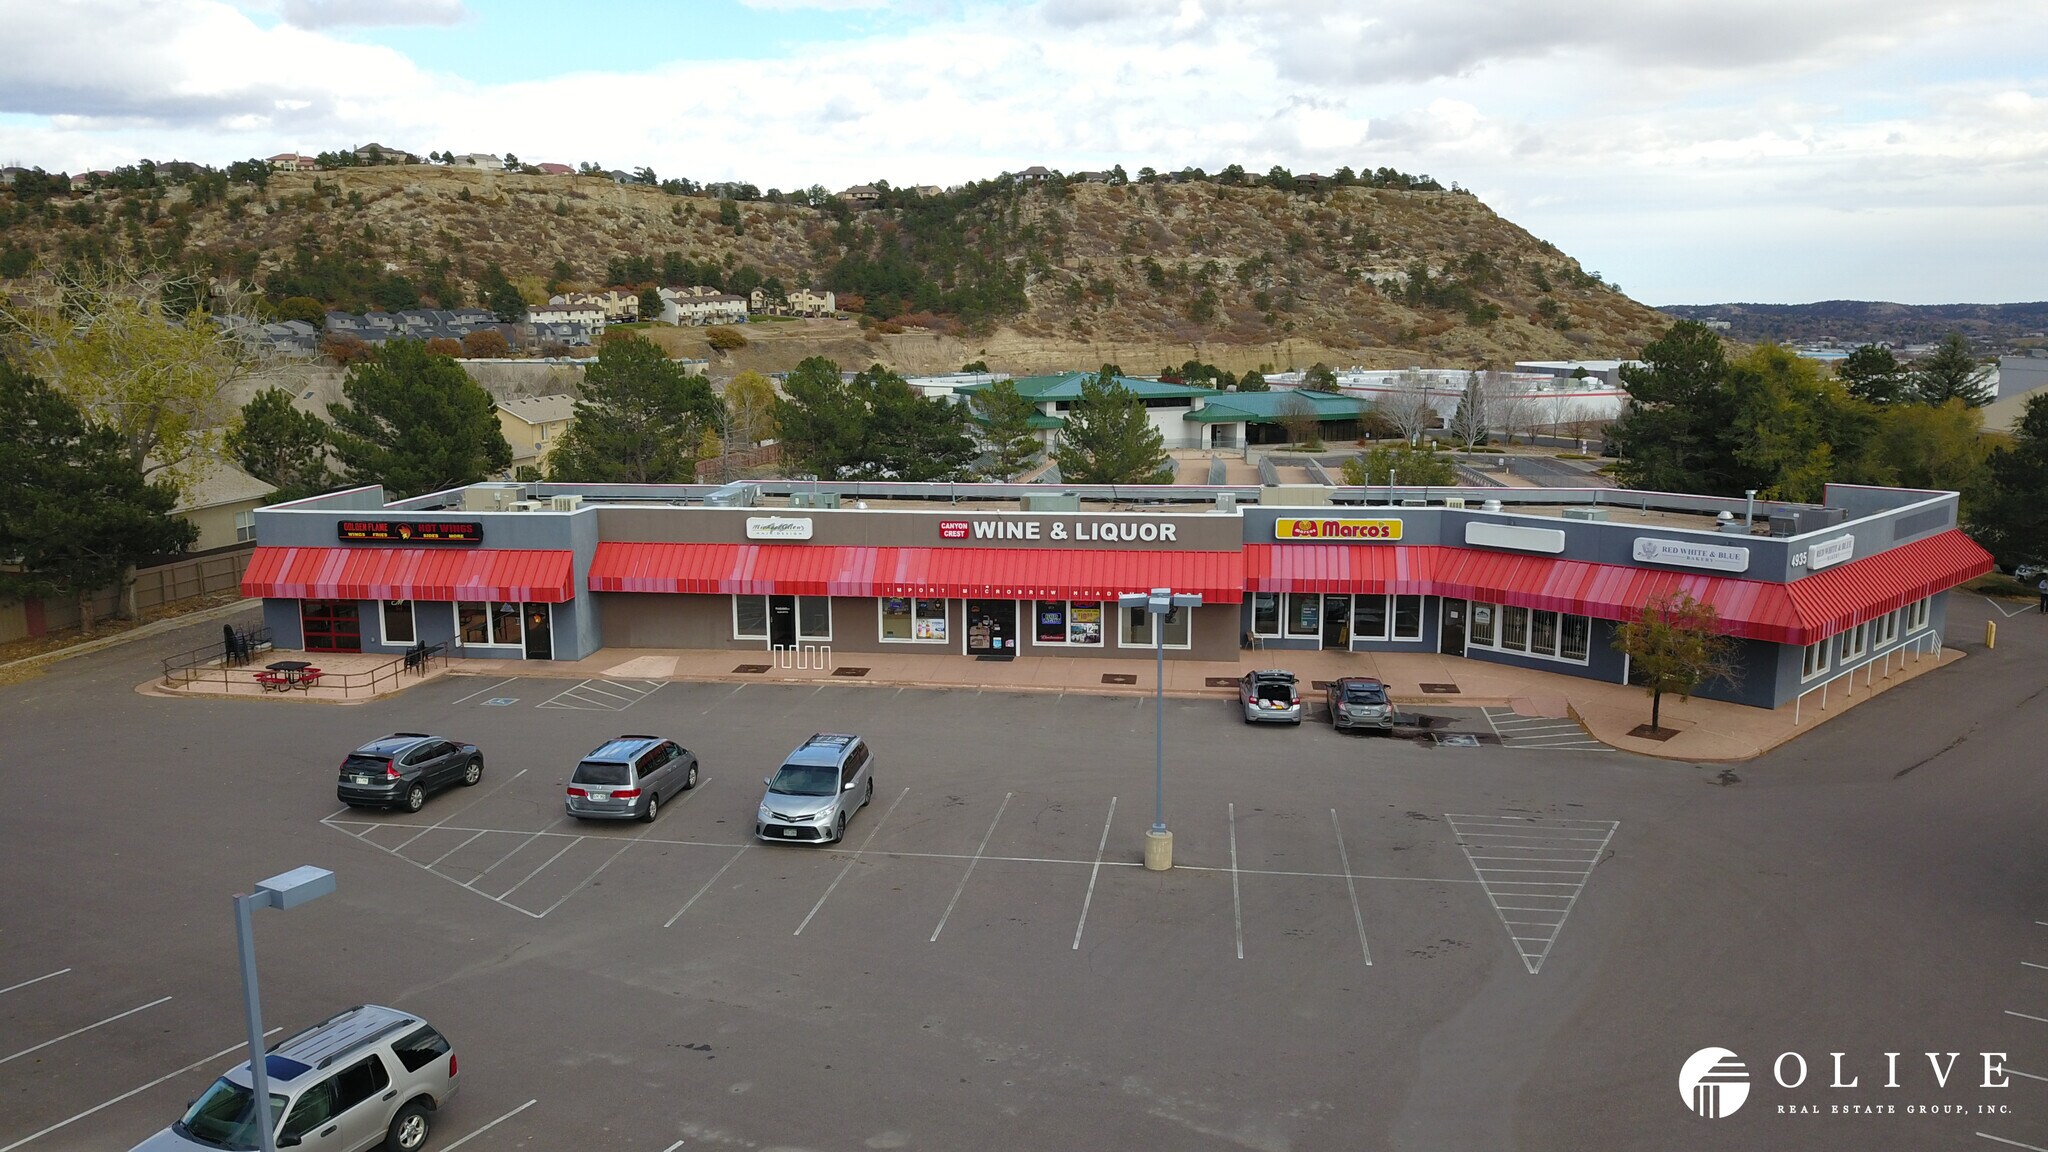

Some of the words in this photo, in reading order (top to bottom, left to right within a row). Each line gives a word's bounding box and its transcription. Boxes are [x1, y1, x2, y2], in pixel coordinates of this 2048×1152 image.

[343, 522, 367, 531] GOLDEN
[367, 522, 389, 532] FLAME
[418, 523, 437, 533] HOT
[439, 524, 473, 533] WINGS
[973, 521, 1041, 539] WINE
[1050, 522, 1068, 540] &
[1075, 523, 1177, 542] LIQUOR
[1322, 520, 1390, 537] Marco's
[1680, 548, 1709, 557] WHITE
[1718, 552, 1741, 560] BLUE
[1791, 552, 1807, 568] 4935
